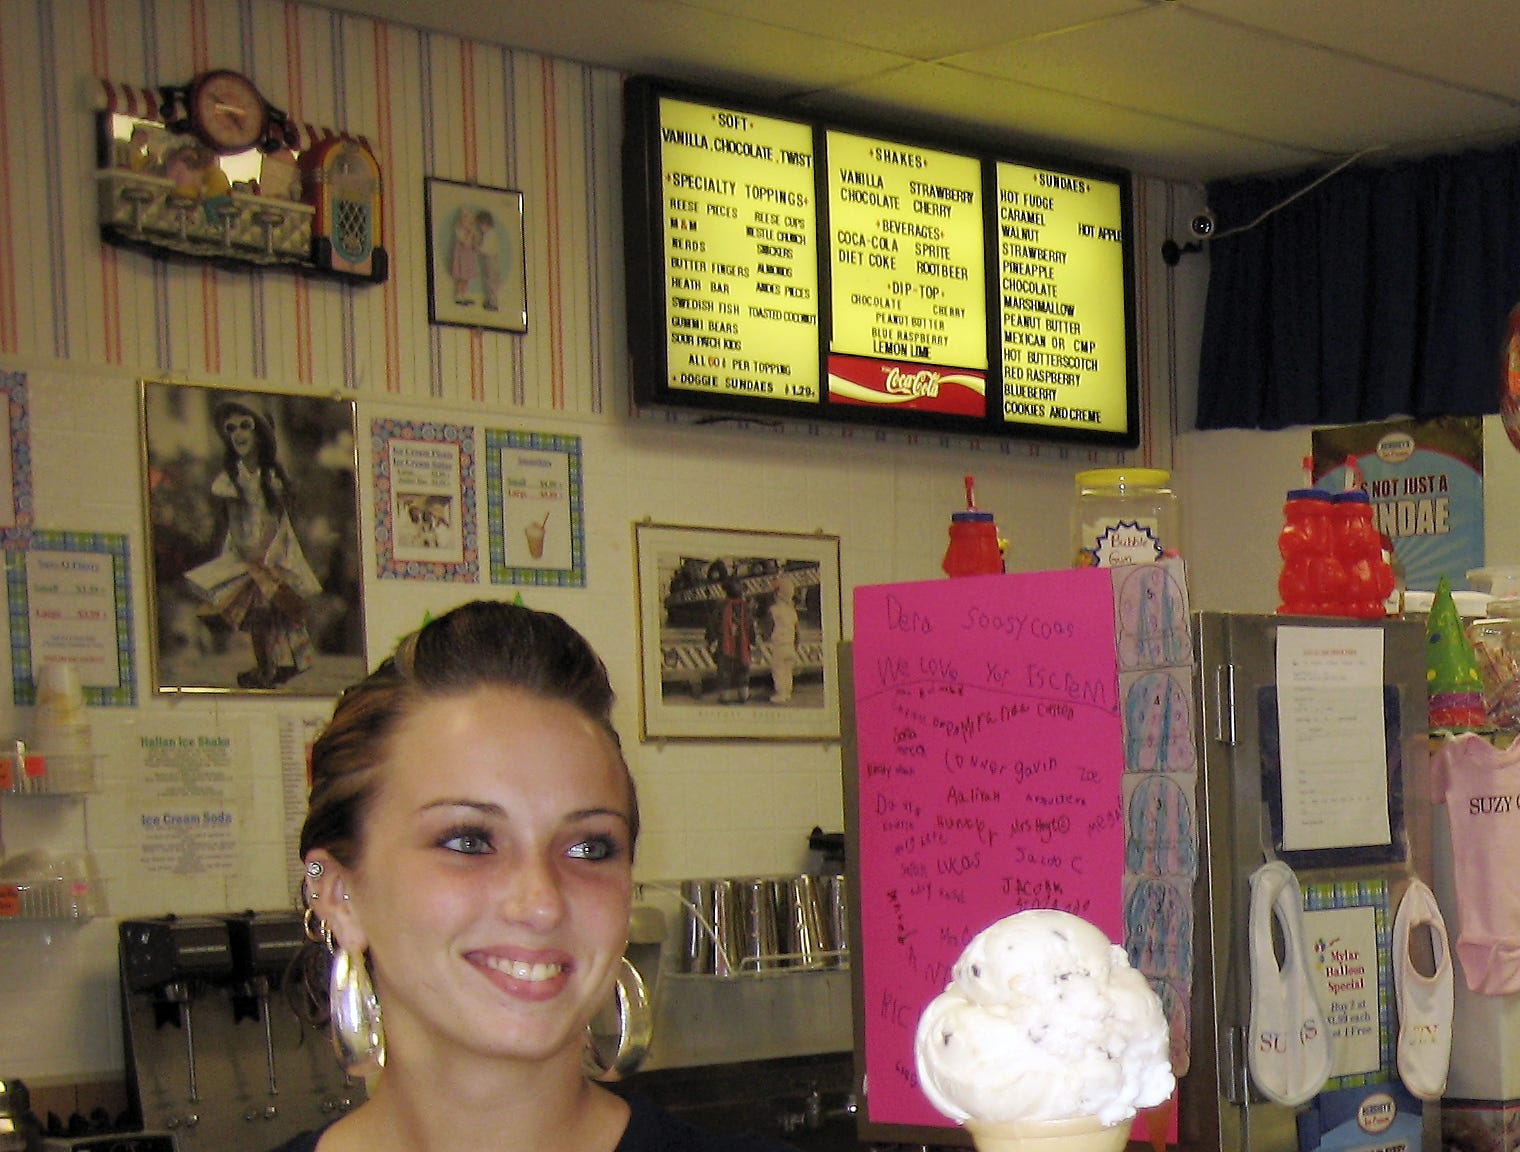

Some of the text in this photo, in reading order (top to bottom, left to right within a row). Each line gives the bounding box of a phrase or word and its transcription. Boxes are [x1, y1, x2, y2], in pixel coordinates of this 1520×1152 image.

[719, 114, 748, 130] SOFT
[780, 149, 811, 168] TWIST
[875, 148, 923, 168] SHAKES
[672, 173, 803, 206] SPECIALTY TOPPINGS
[840, 168, 974, 204] VANILLA STRAWBERRY
[1039, 173, 1085, 193] SUNDAES
[671, 198, 737, 218] REESE PIECES
[841, 188, 951, 218] CHOCOLATE CHERRY
[1000, 190, 1054, 210] HOT FUDGE
[755, 211, 780, 225] REESE
[1001, 207, 1046, 225] CARAMEL
[882, 219, 940, 240] BEVERAGES
[1001, 225, 1040, 242] WALNUT
[1078, 223, 1094, 238] HOT
[672, 238, 705, 252] NERDS
[915, 242, 950, 260] SPRITE
[1002, 243, 1067, 264] STRAWBERRY
[671, 257, 749, 277] BUTTER FINGERS
[839, 249, 896, 270] DIET COKE
[1003, 261, 1054, 280] PINEAPPLE
[671, 277, 729, 295] HEATH BAR
[1003, 279, 1057, 297] CHOCOLATE
[719, 302, 739, 315] FISH
[851, 294, 965, 319] CHOCOLATE CHERRY
[1003, 296, 1075, 317] MARSHMALLOW
[709, 320, 738, 334] BEARS
[876, 313, 944, 330] PEANUT BUTTER
[1003, 314, 1081, 334] PEANUT BUTTER
[872, 328, 949, 346] BLUE RASPBERRY
[1004, 331, 1095, 354] MEXICAN OR CMP
[873, 340, 907, 357] LEMON
[733, 359, 749, 371] PER
[1003, 348, 1098, 371] HOT BUTTERSCOTCH
[726, 377, 773, 392] SUNDAES
[1004, 366, 1081, 387] RED RASPBERRY
[1004, 383, 1056, 402] BLUEBERRY
[1005, 401, 1045, 418] COOKIES
[1373, 480, 1399, 498] NOT
[1404, 476, 1434, 495] JUST
[1439, 474, 1447, 492] A
[1469, 797, 1512, 815] SUZY
[142, 812, 232, 825] Ice Cream Soda
[1331, 949, 1359, 963] Mylar
[1326, 966, 1364, 977] Balloon
[1328, 978, 1364, 994] Special
